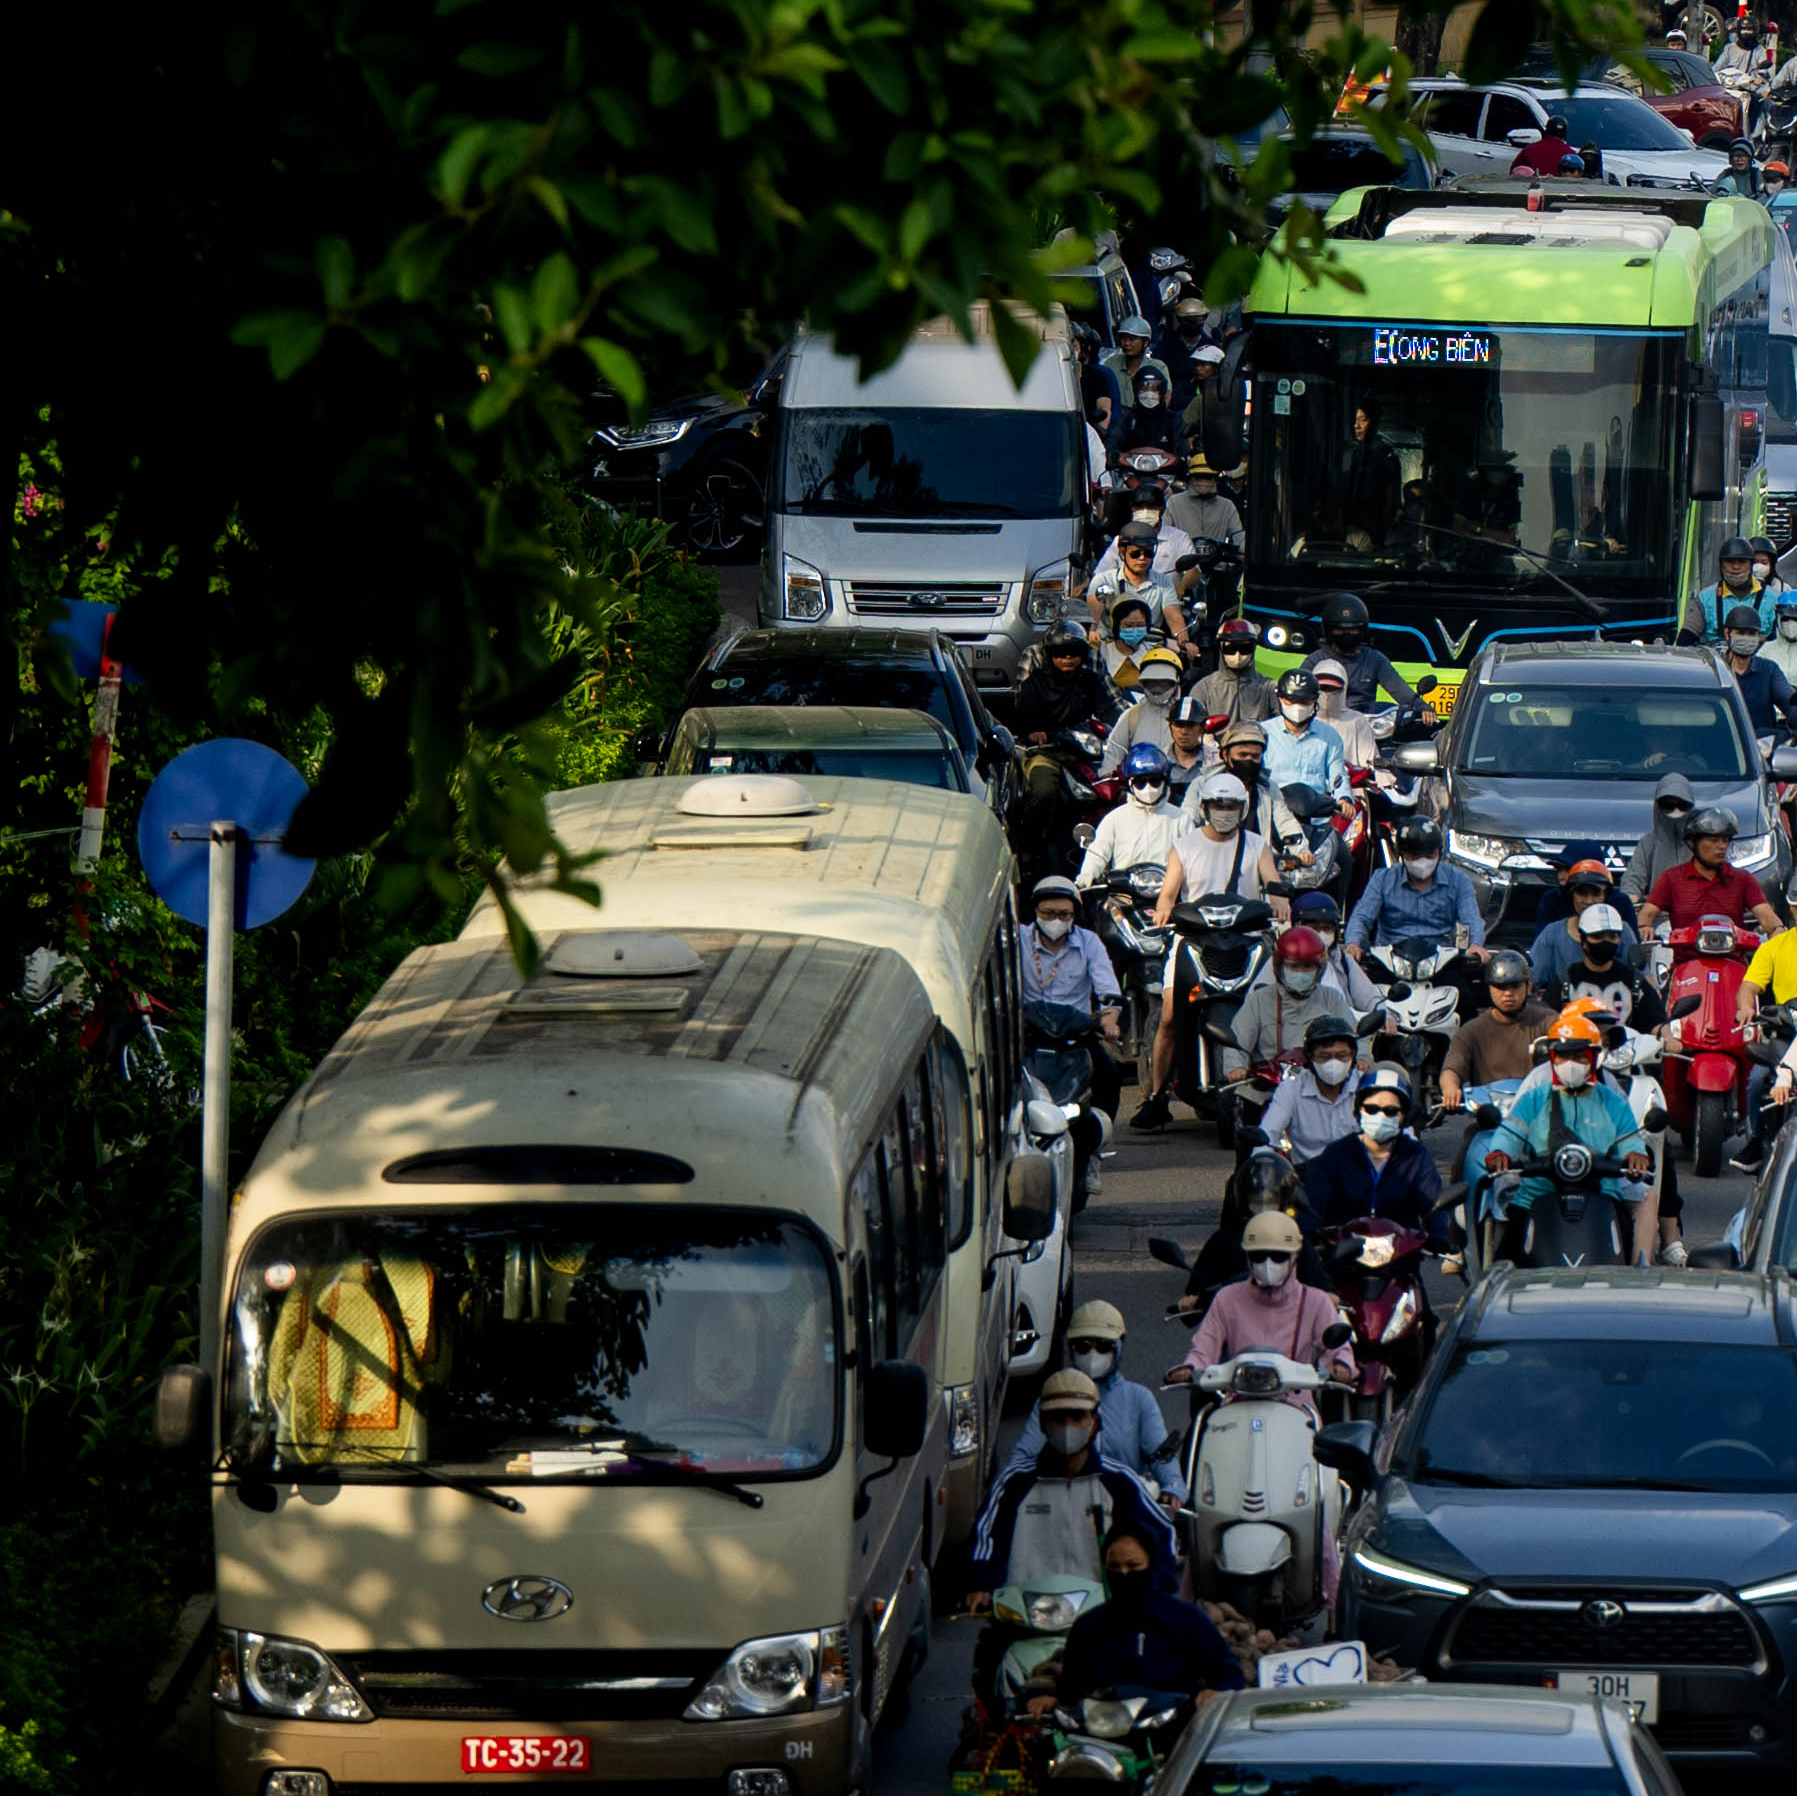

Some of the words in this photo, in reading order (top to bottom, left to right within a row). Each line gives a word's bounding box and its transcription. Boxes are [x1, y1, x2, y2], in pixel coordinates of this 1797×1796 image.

[1446, 332, 1489, 362] BIÊN
[1551, 830, 1632, 840] OUTLAN
[1587, 1676, 1630, 1698] 30H
[465, 1738, 585, 1768] TC-35-22
